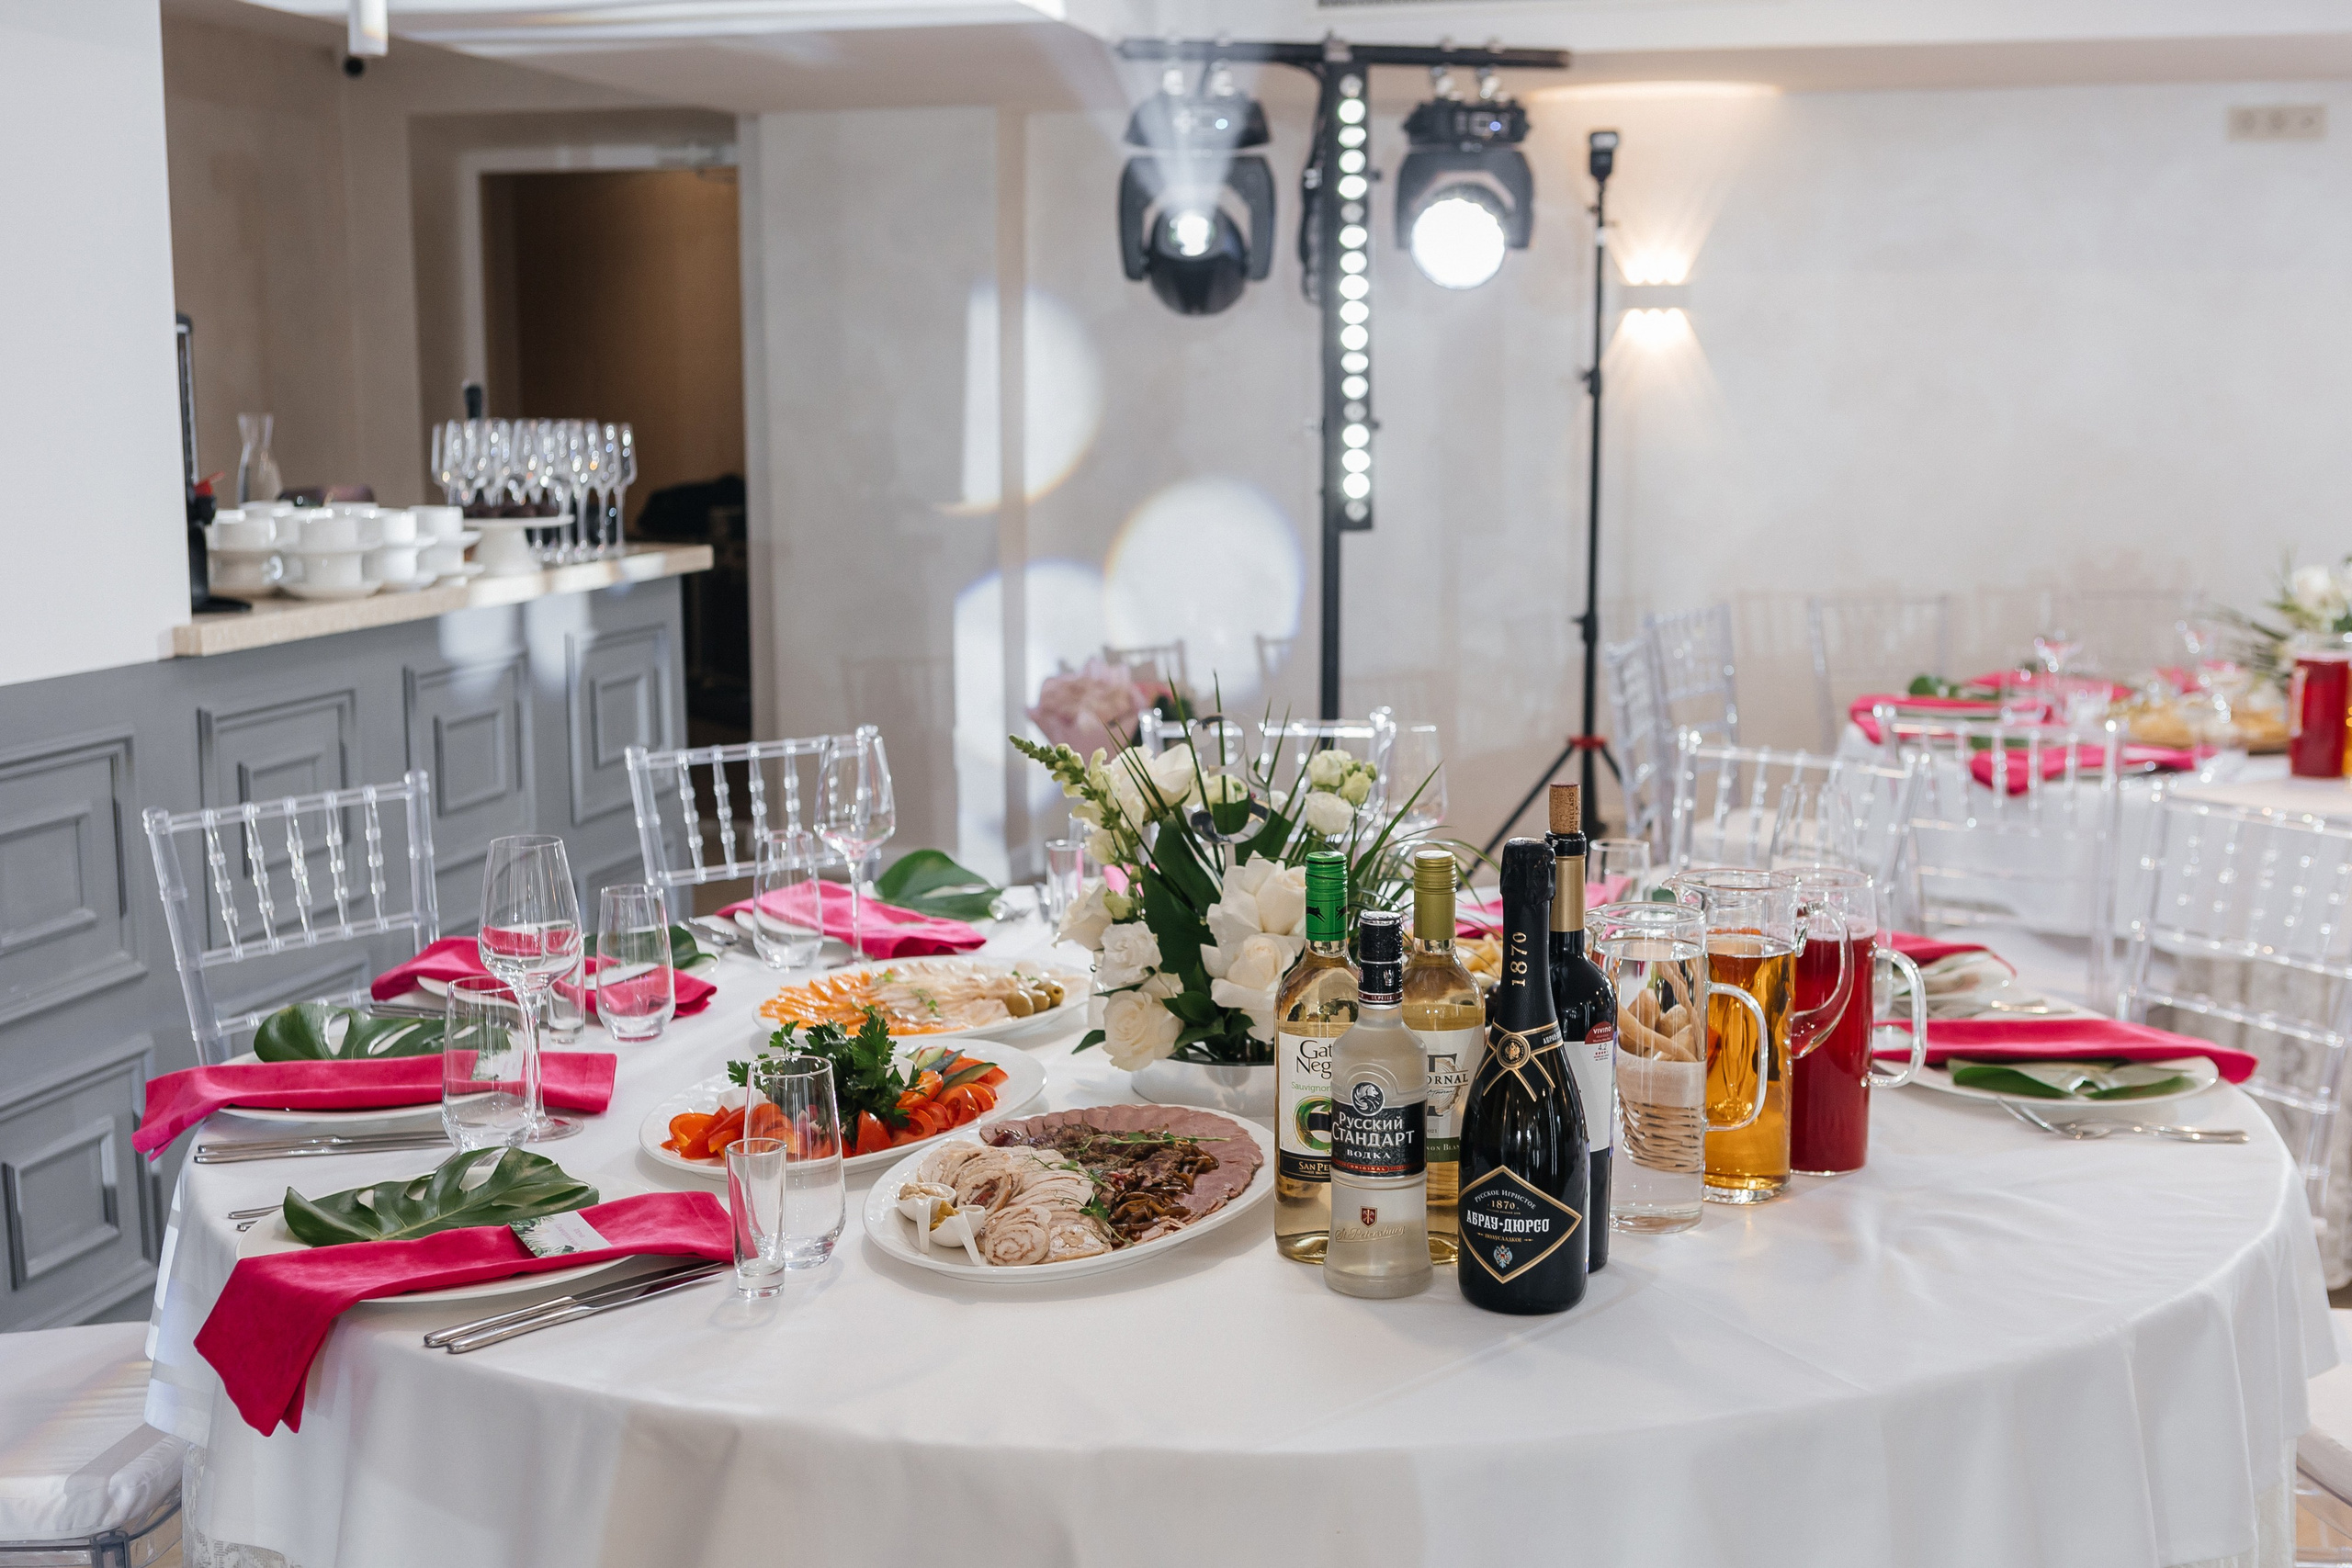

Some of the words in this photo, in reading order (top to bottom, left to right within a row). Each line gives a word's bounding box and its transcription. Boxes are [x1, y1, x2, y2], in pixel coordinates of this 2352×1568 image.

[1510, 931, 1528, 987] 1870
[1299, 1039, 1333, 1059] Gat
[1295, 1055, 1332, 1080] Neg
[1427, 1073, 1469, 1085] ORNAL
[1347, 1149, 1392, 1160] ВОДКА
[1350, 1164, 1386, 1172] ORIGINAL
[1474, 1190, 1500, 1203] РУССКОЕ
[1501, 1189, 1537, 1210] ИГРИСТОЕ
[1490, 1200, 1516, 1210] 1870
[1466, 1209, 1551, 1234] АБРАУ-ДЮРСО
